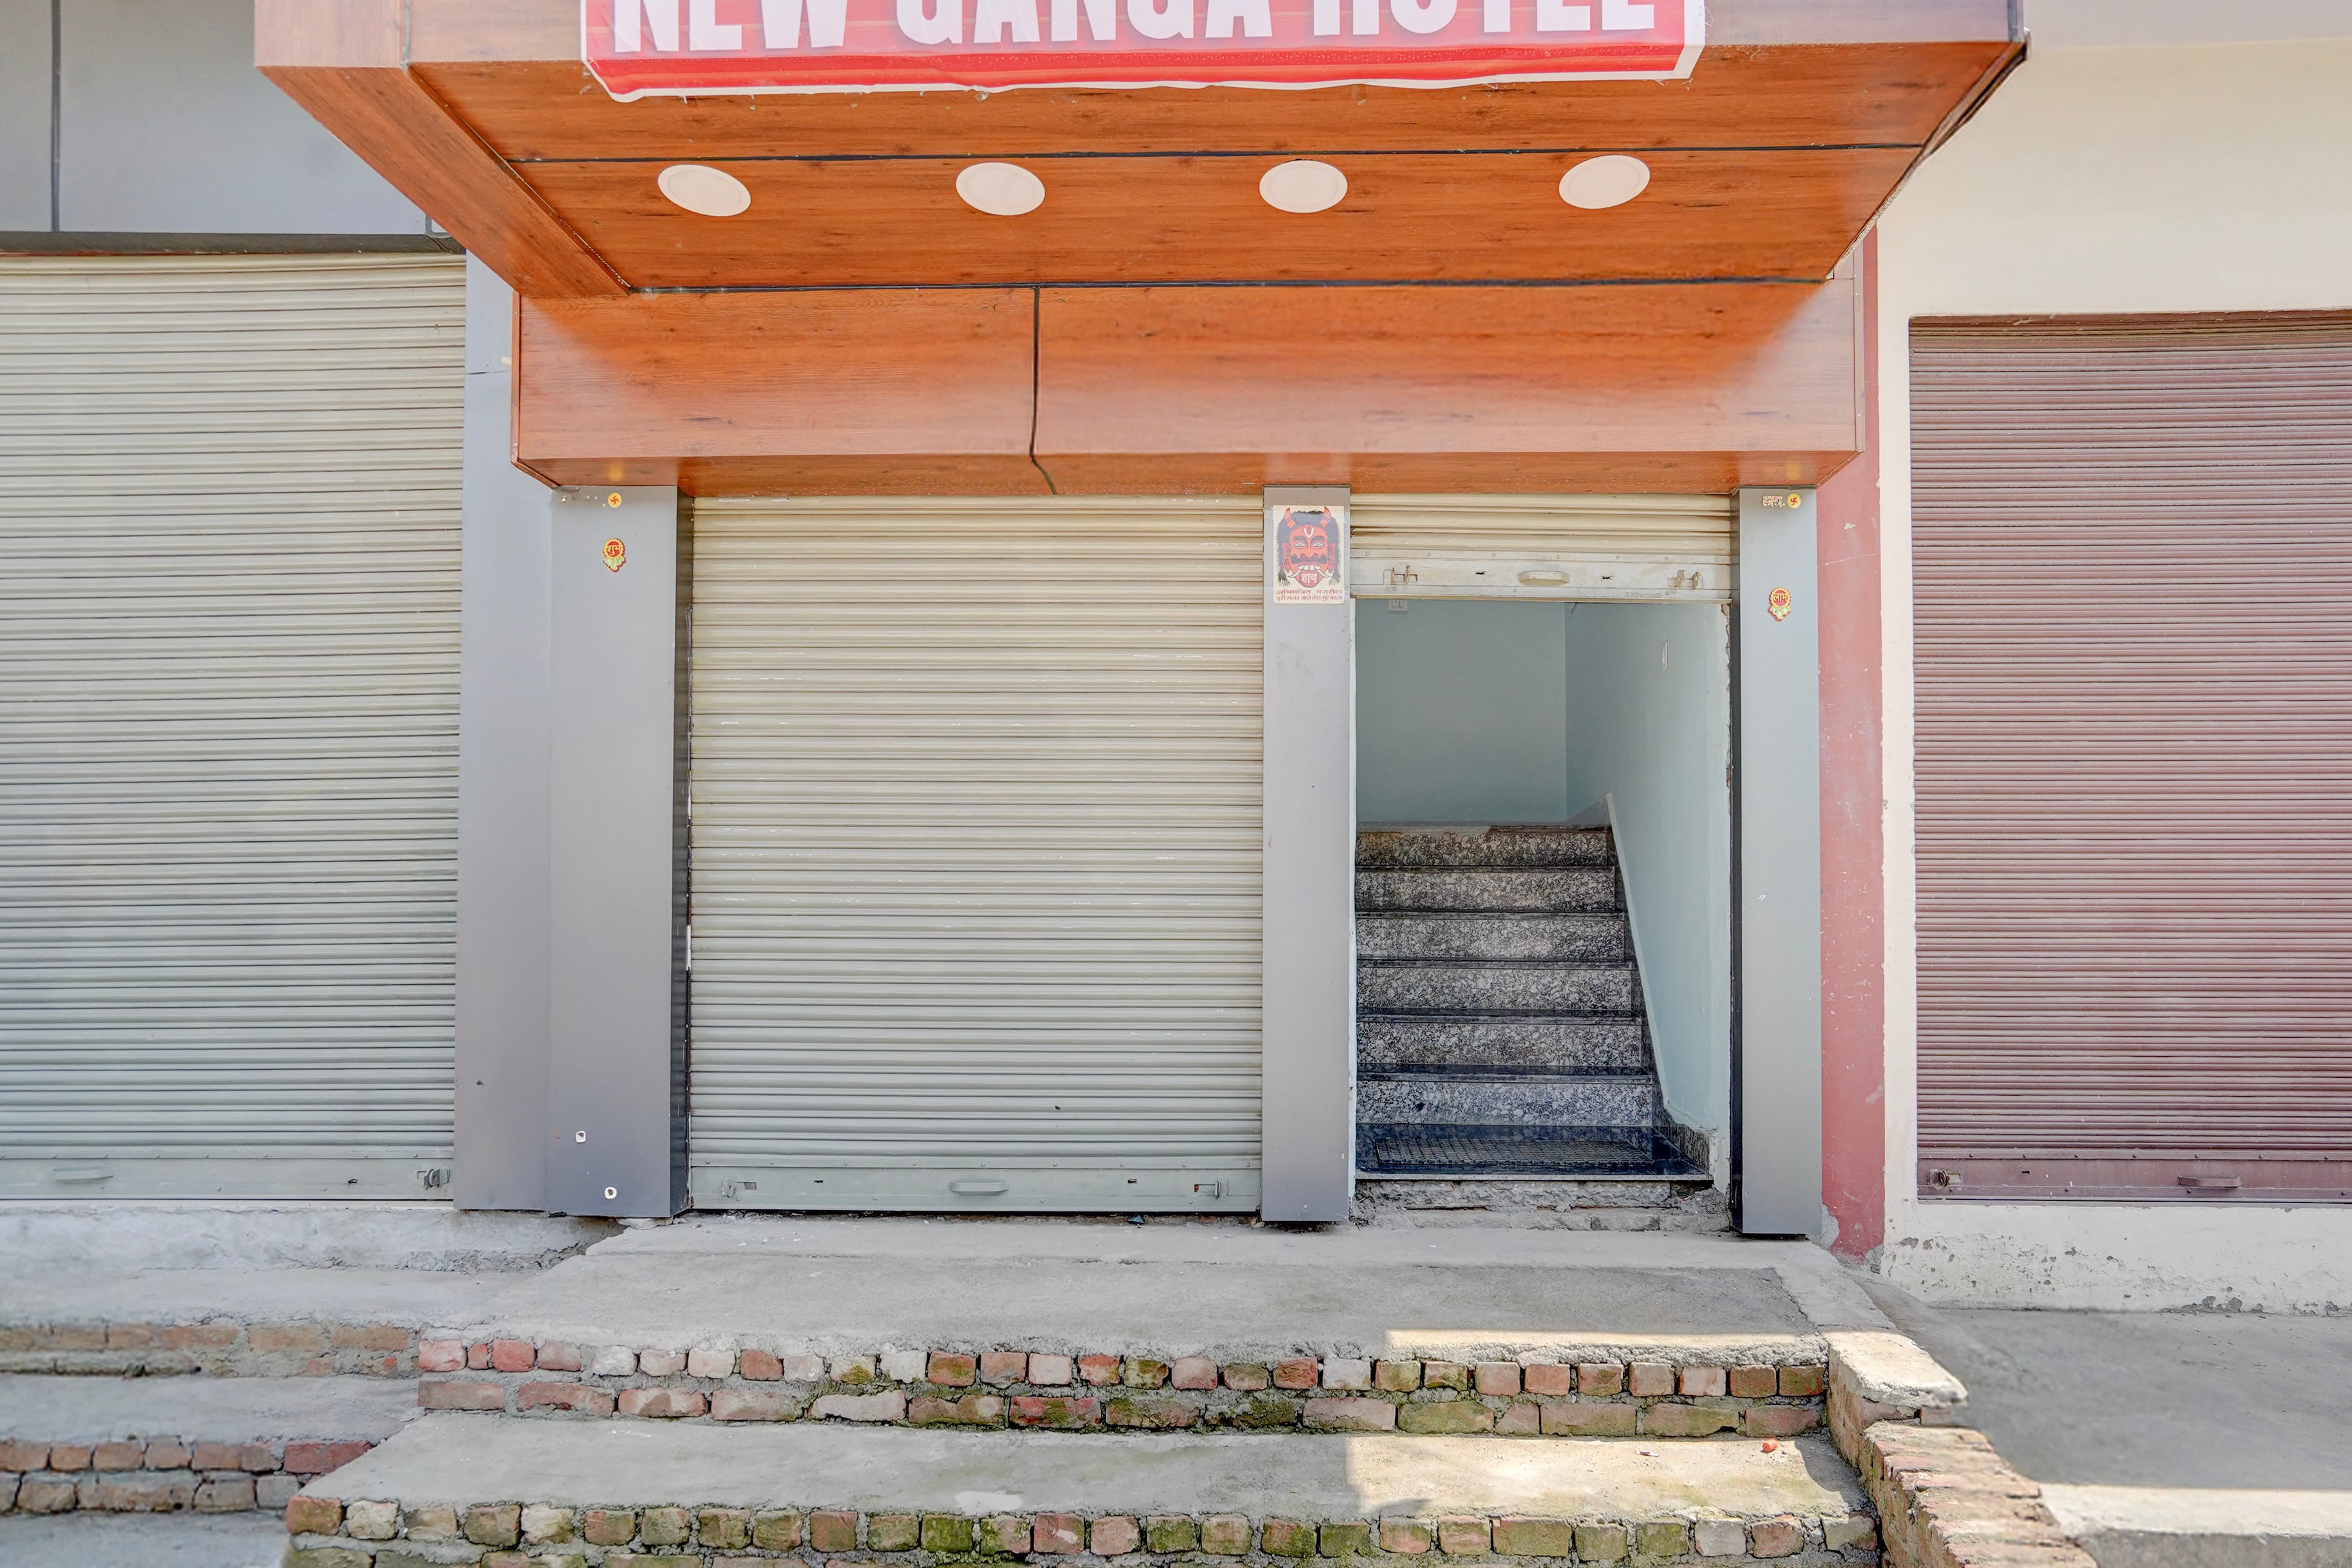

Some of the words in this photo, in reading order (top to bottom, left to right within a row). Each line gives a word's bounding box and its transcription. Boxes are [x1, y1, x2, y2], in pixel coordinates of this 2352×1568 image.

[606, 544, 621, 555] शुभ
[1301, 574, 1318, 583] हाय
[1773, 593, 1788, 602] लाभ
